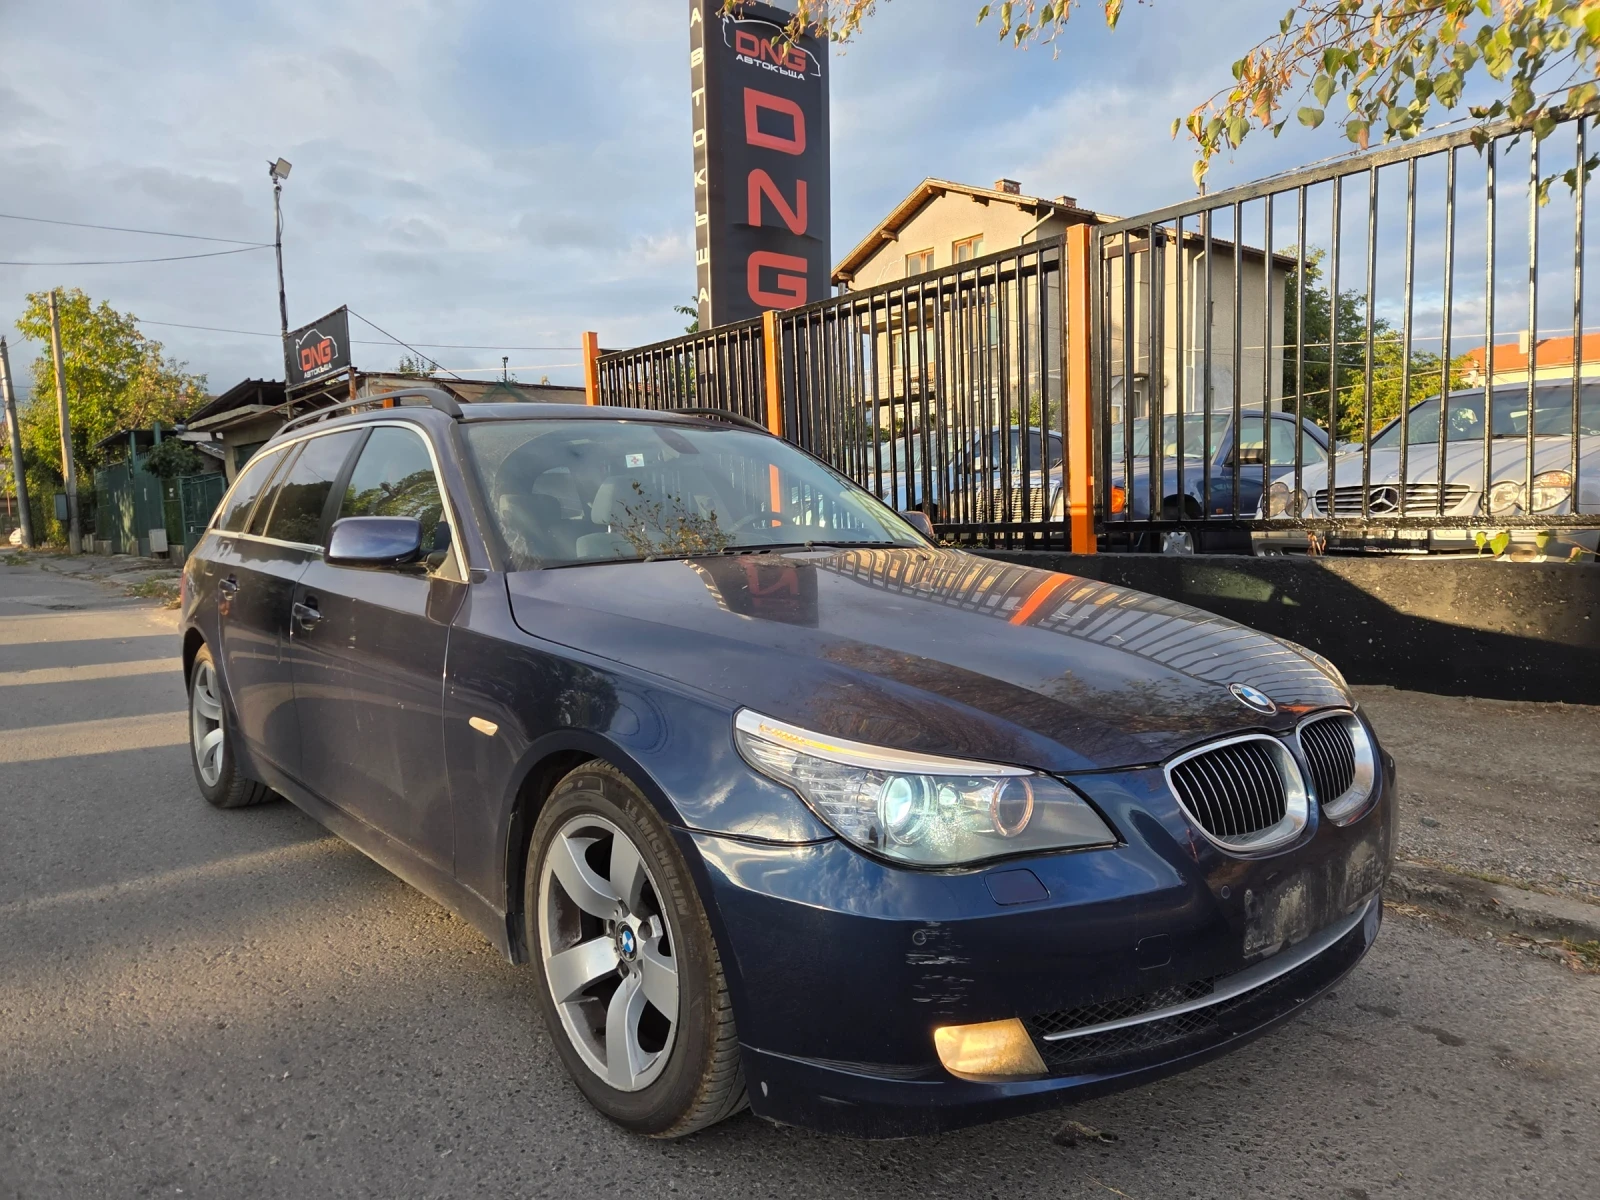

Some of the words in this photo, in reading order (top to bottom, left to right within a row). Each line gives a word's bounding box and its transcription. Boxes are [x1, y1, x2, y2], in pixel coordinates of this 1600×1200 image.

[736, 30, 806, 72] DNG
[736, 54, 805, 80] АВТОКЪЩА
[744, 87, 807, 310] DNG
[301, 339, 332, 371] DNG
[637, 816, 691, 915] MICHELIN
